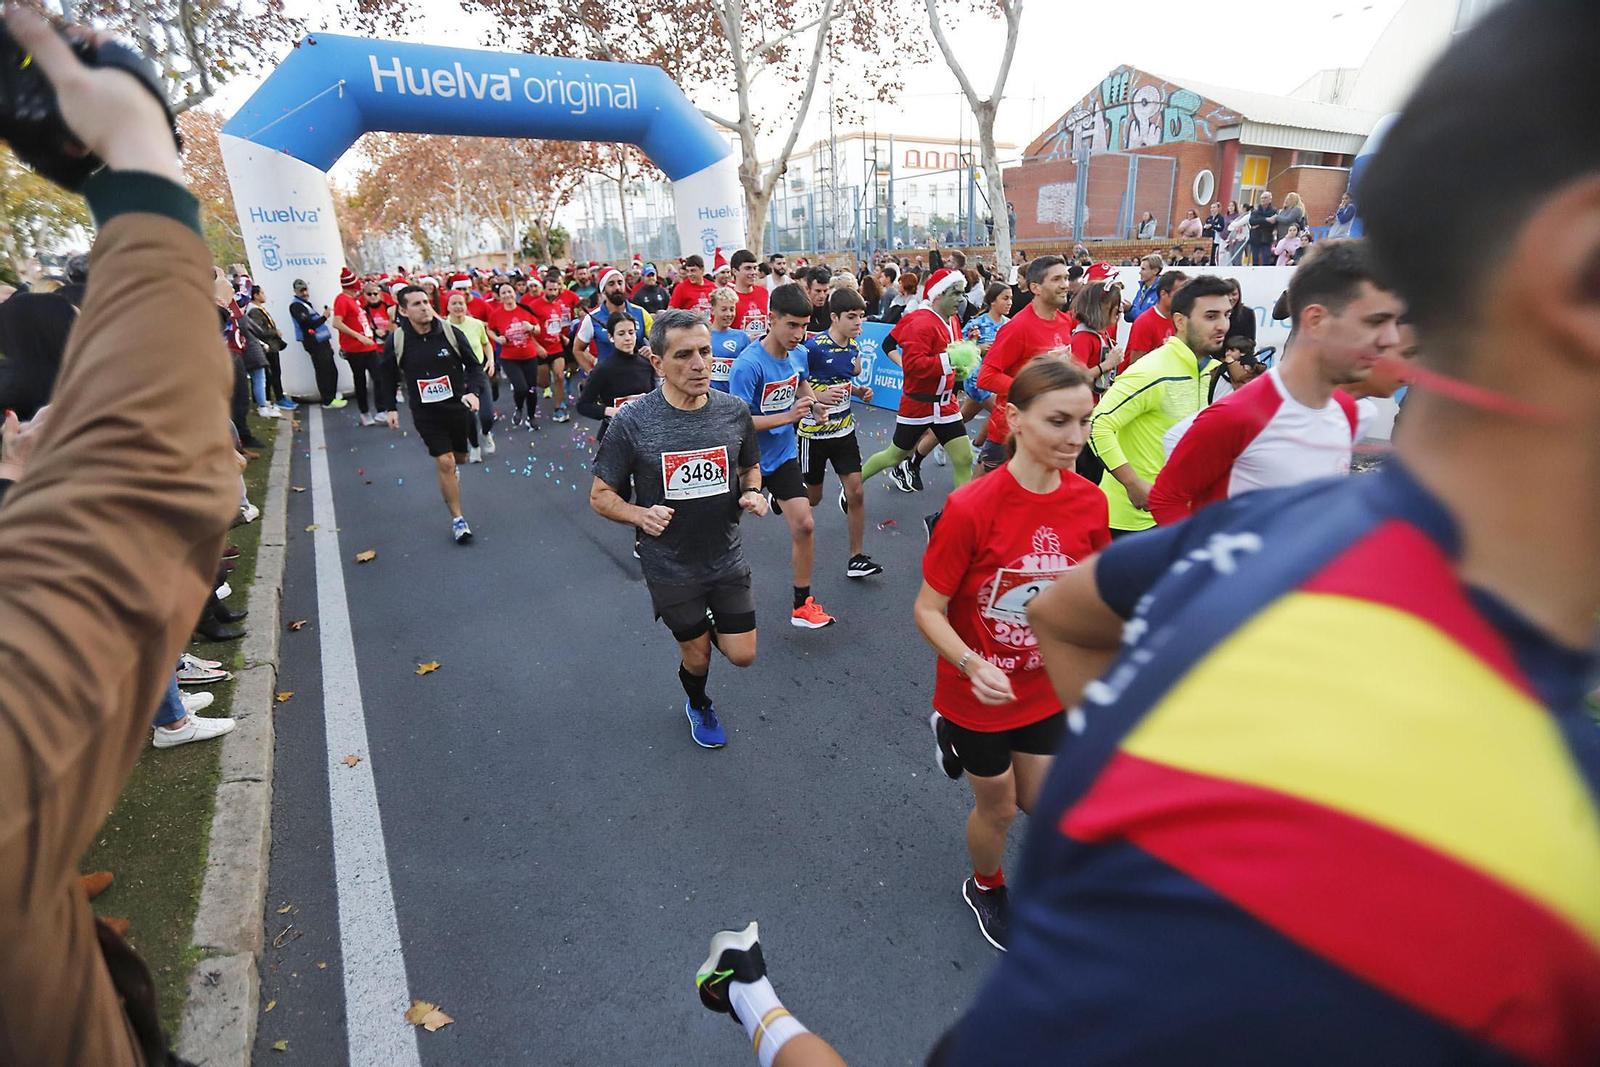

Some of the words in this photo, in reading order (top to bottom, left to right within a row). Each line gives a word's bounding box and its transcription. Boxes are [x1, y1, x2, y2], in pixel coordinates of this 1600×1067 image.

[368, 54, 512, 102] Huelva
[523, 70, 639, 115] original
[249, 206, 319, 223] Huelva
[698, 204, 741, 220] Huelva
[285, 257, 328, 266] HUELVA
[750, 320, 762, 331] 391
[711, 363, 728, 374] 240
[427, 384, 444, 395] 448
[772, 386, 792, 402] 226
[681, 462, 713, 484] 348
